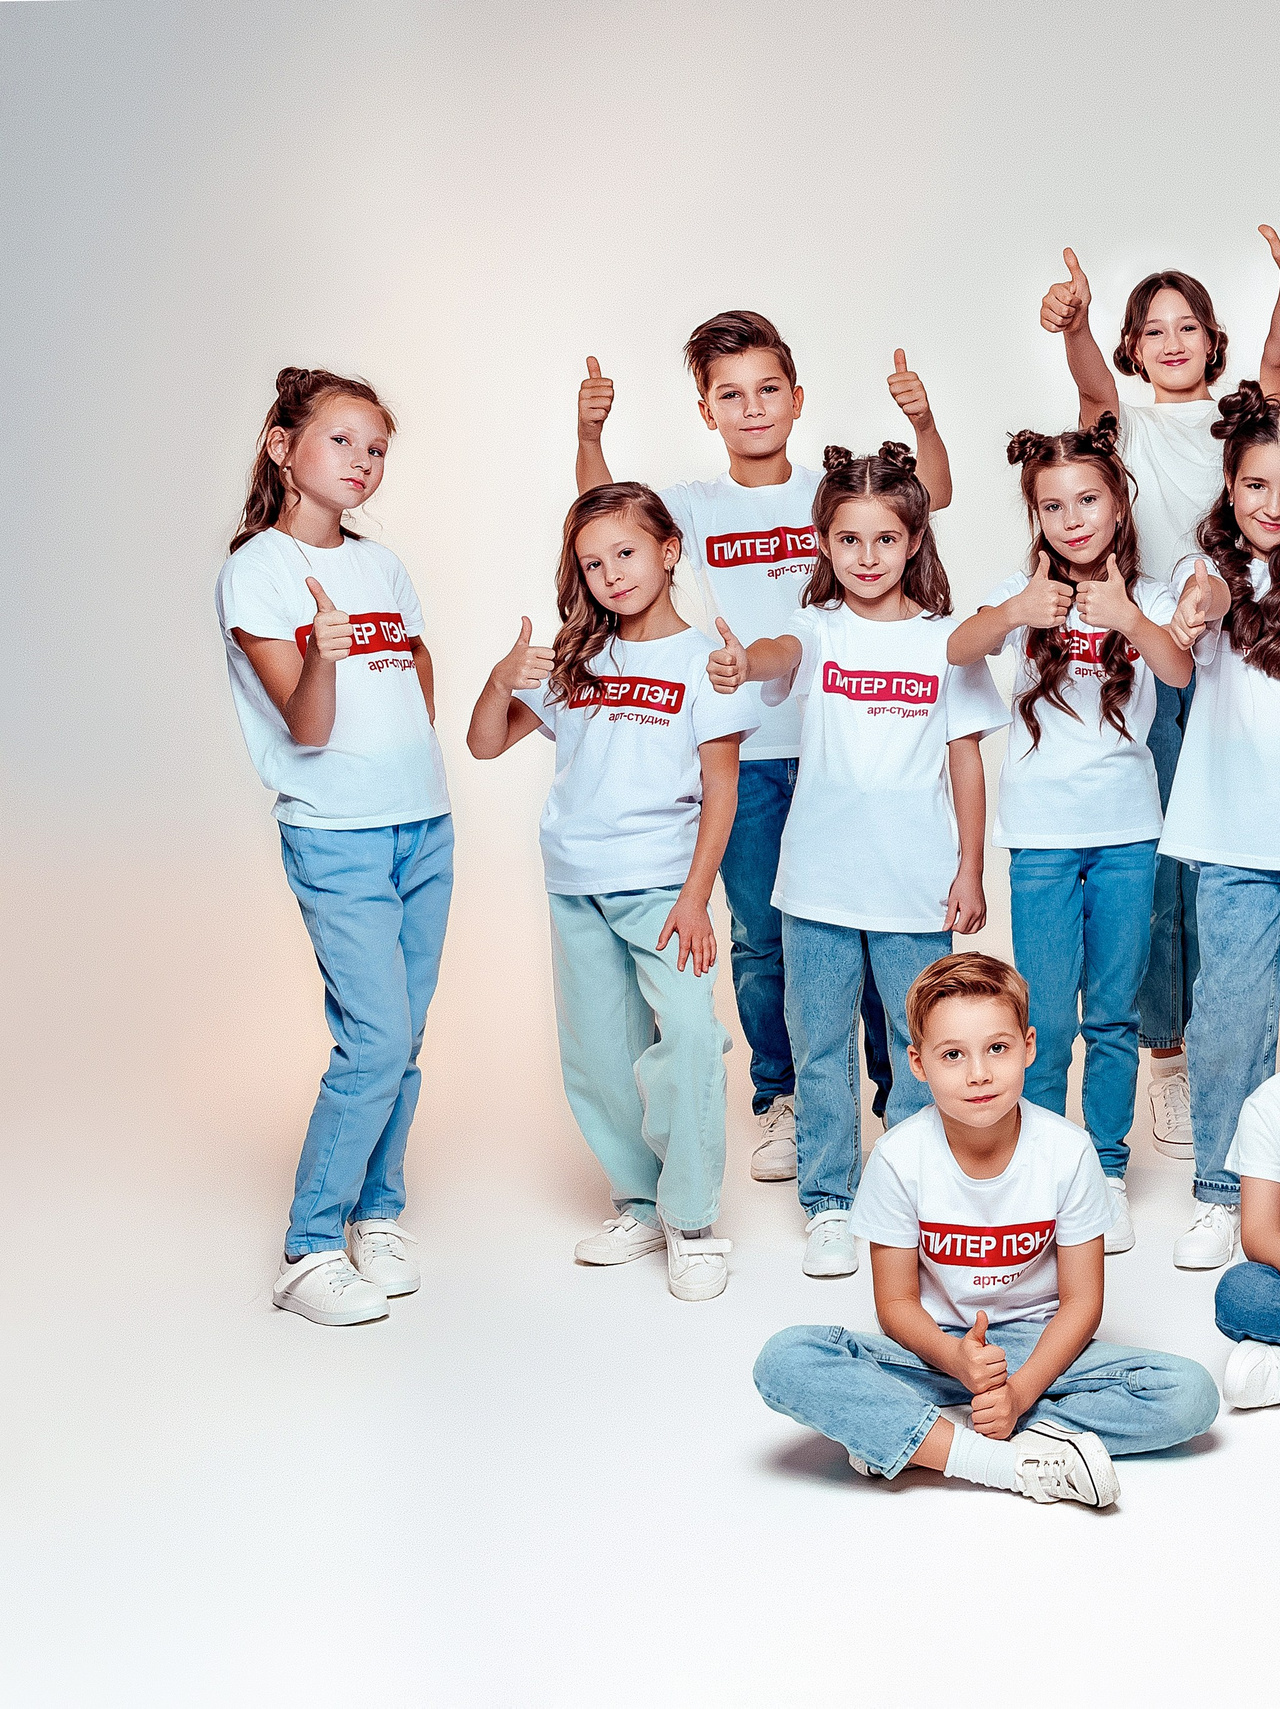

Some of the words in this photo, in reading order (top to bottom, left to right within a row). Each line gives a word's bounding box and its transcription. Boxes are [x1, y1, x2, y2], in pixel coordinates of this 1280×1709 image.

[713, 536, 780, 561] ПИТЕР
[632, 683, 678, 707] ПЭН
[827, 668, 887, 694] ПИТЕР
[892, 678, 932, 698] ПЭН
[608, 712, 670, 727] арт-студия
[867, 706, 929, 718] арт-студия
[921, 1229, 997, 1258] ПИТЕР
[1002, 1228, 1051, 1257] ПЭН
